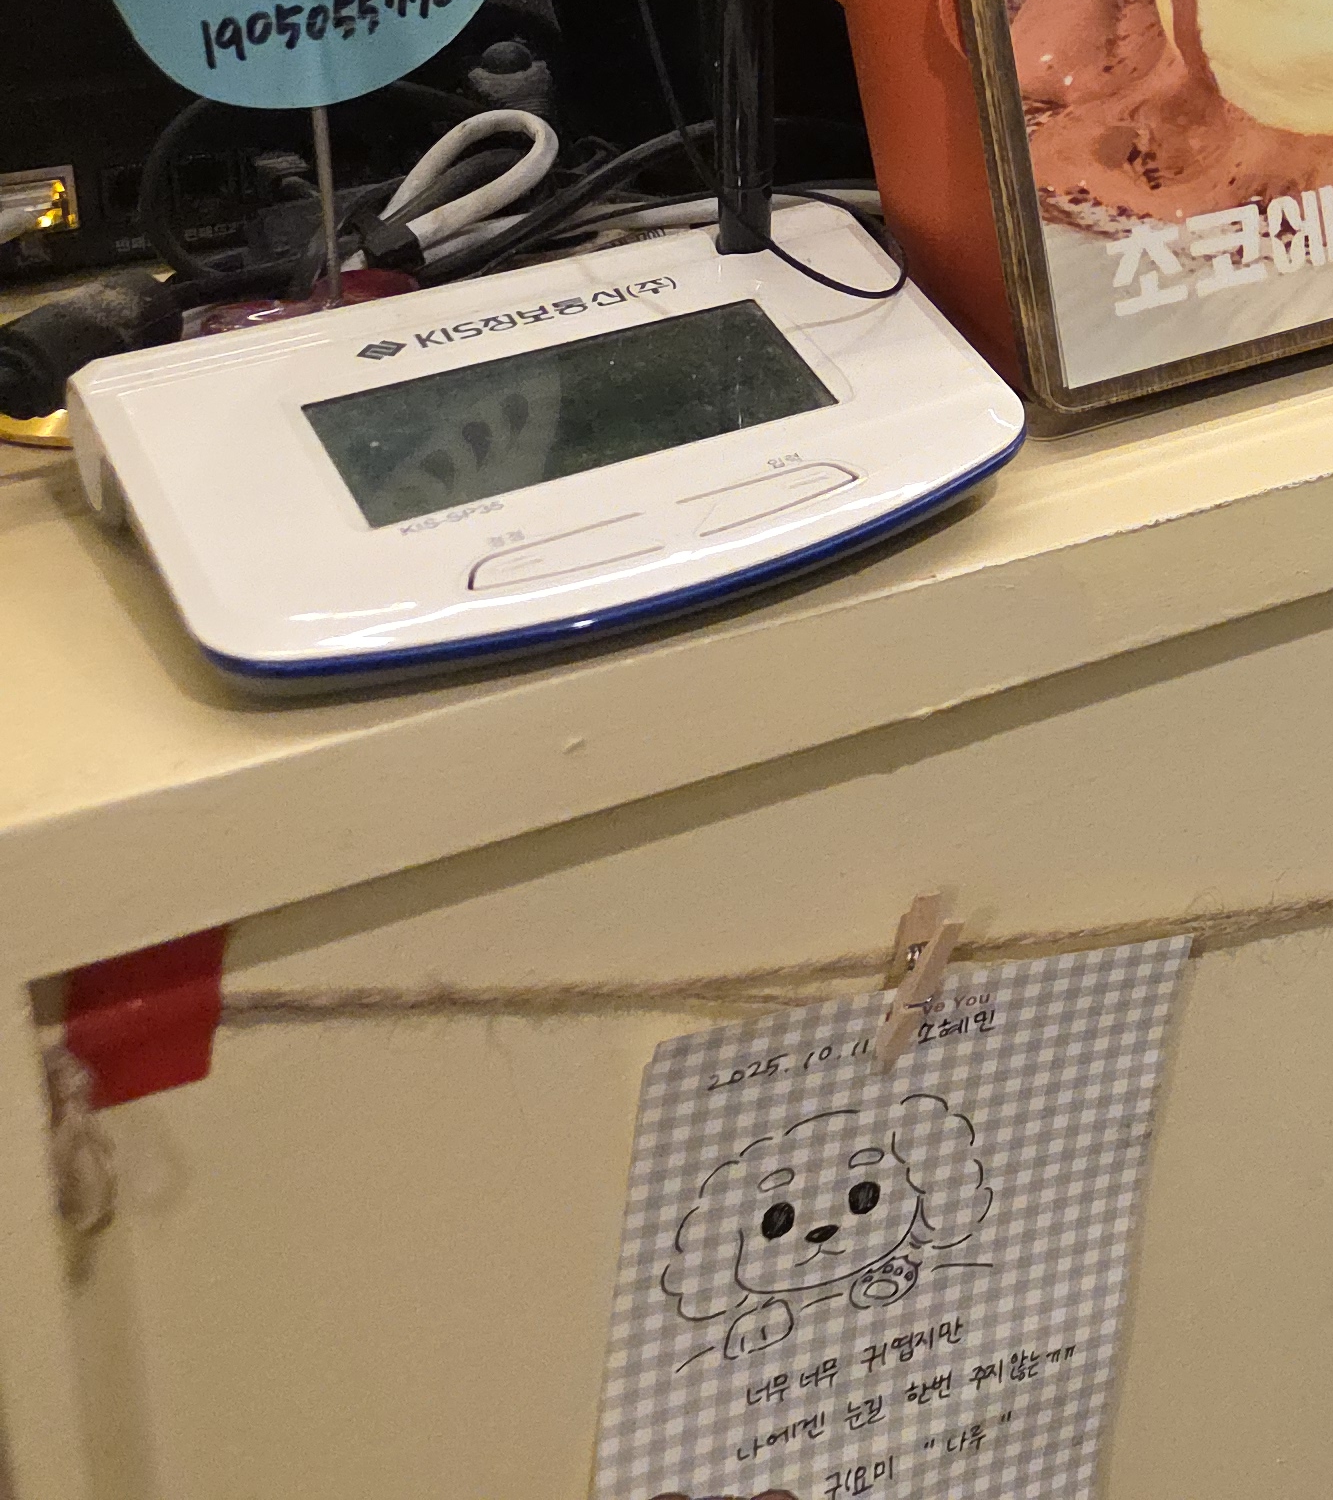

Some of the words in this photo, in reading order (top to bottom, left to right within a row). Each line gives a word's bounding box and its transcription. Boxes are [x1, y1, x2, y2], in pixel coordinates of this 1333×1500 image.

[415, 277, 678, 348] KIS정보통신(주)
[862, 1316, 964, 1374] 귀엽지만
[737, 1413, 826, 1462] 나에겐
[846, 1398, 886, 1429] 눈길
[904, 1372, 953, 1405] 한번
[968, 1359, 1003, 1390] 주지
[824, 1455, 895, 1499] 귀요미
